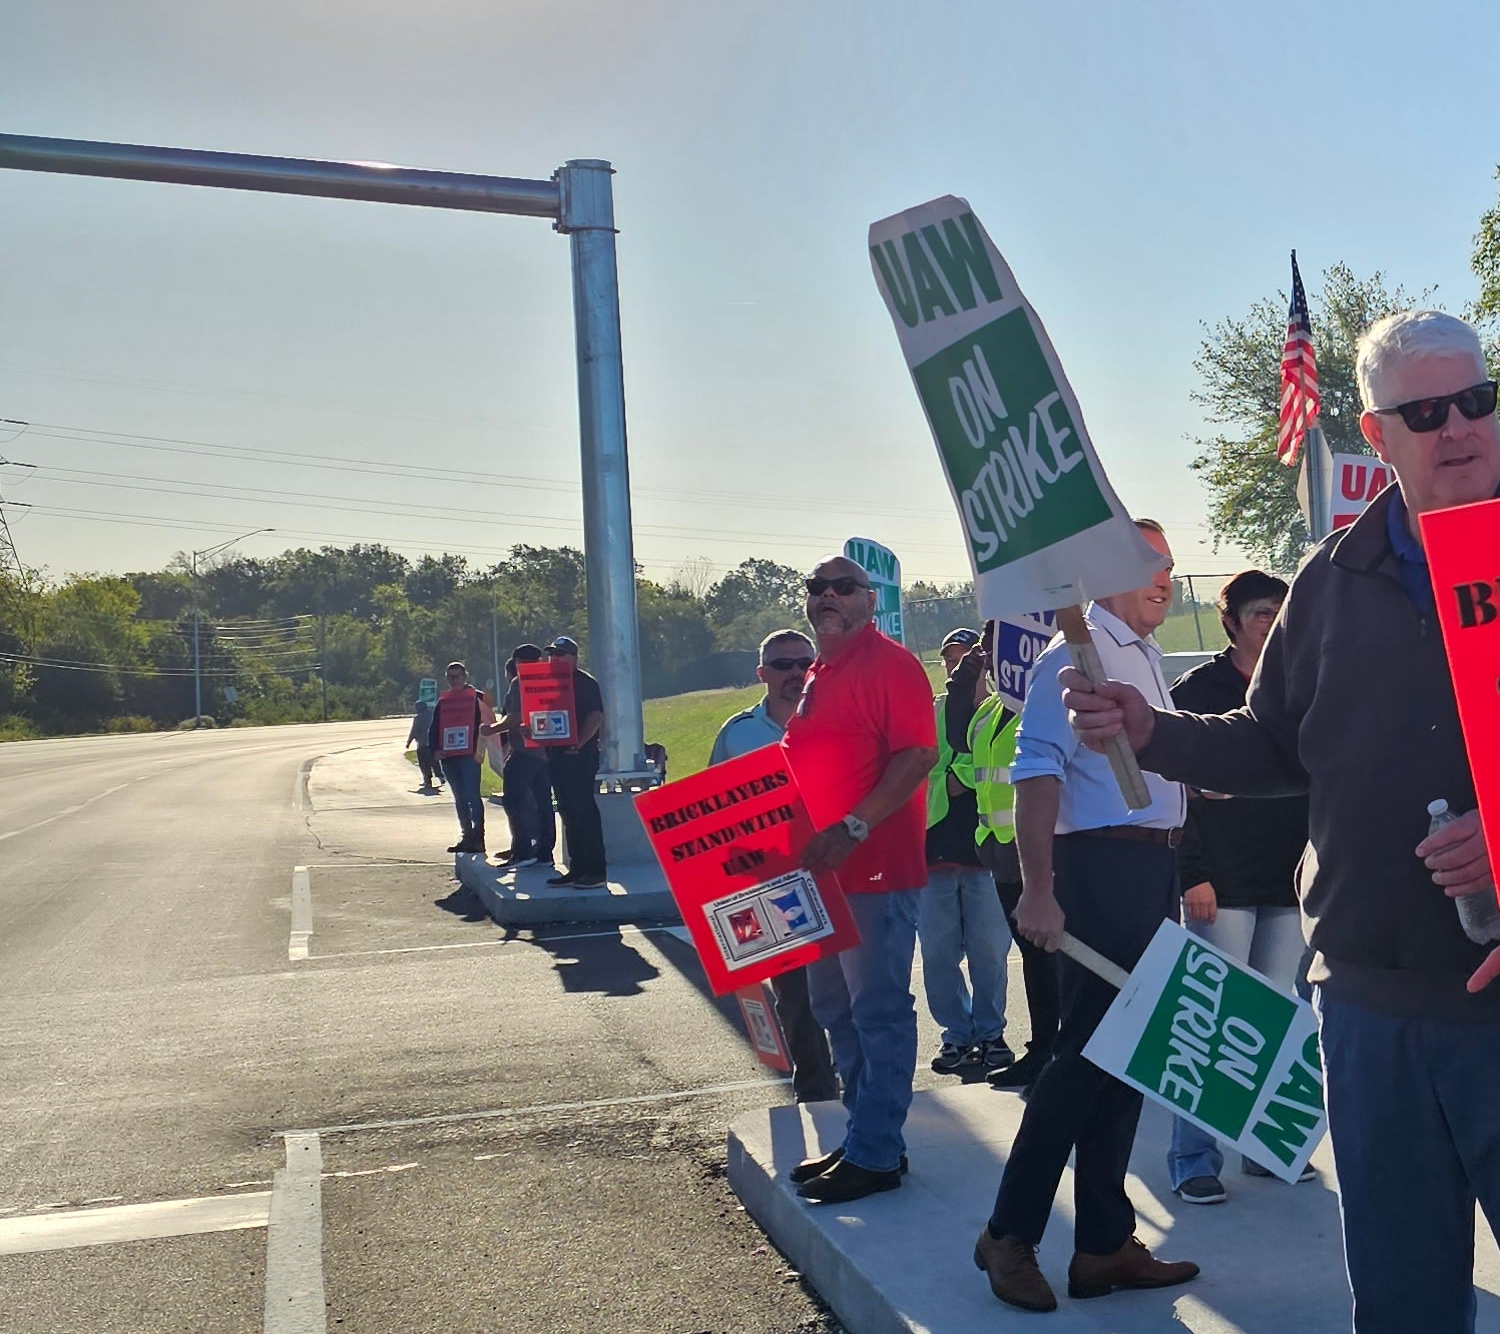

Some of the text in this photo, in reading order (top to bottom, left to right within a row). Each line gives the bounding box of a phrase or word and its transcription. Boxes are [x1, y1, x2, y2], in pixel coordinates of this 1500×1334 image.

[870, 213, 1003, 328] UAW
[948, 345, 1008, 449] ON
[961, 392, 1083, 562] STRIKE
[1341, 464, 1397, 502] UA
[848, 540, 896, 581] UAW
[650, 769, 789, 834] BRICKLAYERS
[670, 804, 795, 862] STAND WITH
[721, 849, 766, 876] UAW
[1158, 944, 1229, 1114] STRIKE
[1214, 1016, 1266, 1091] ON
